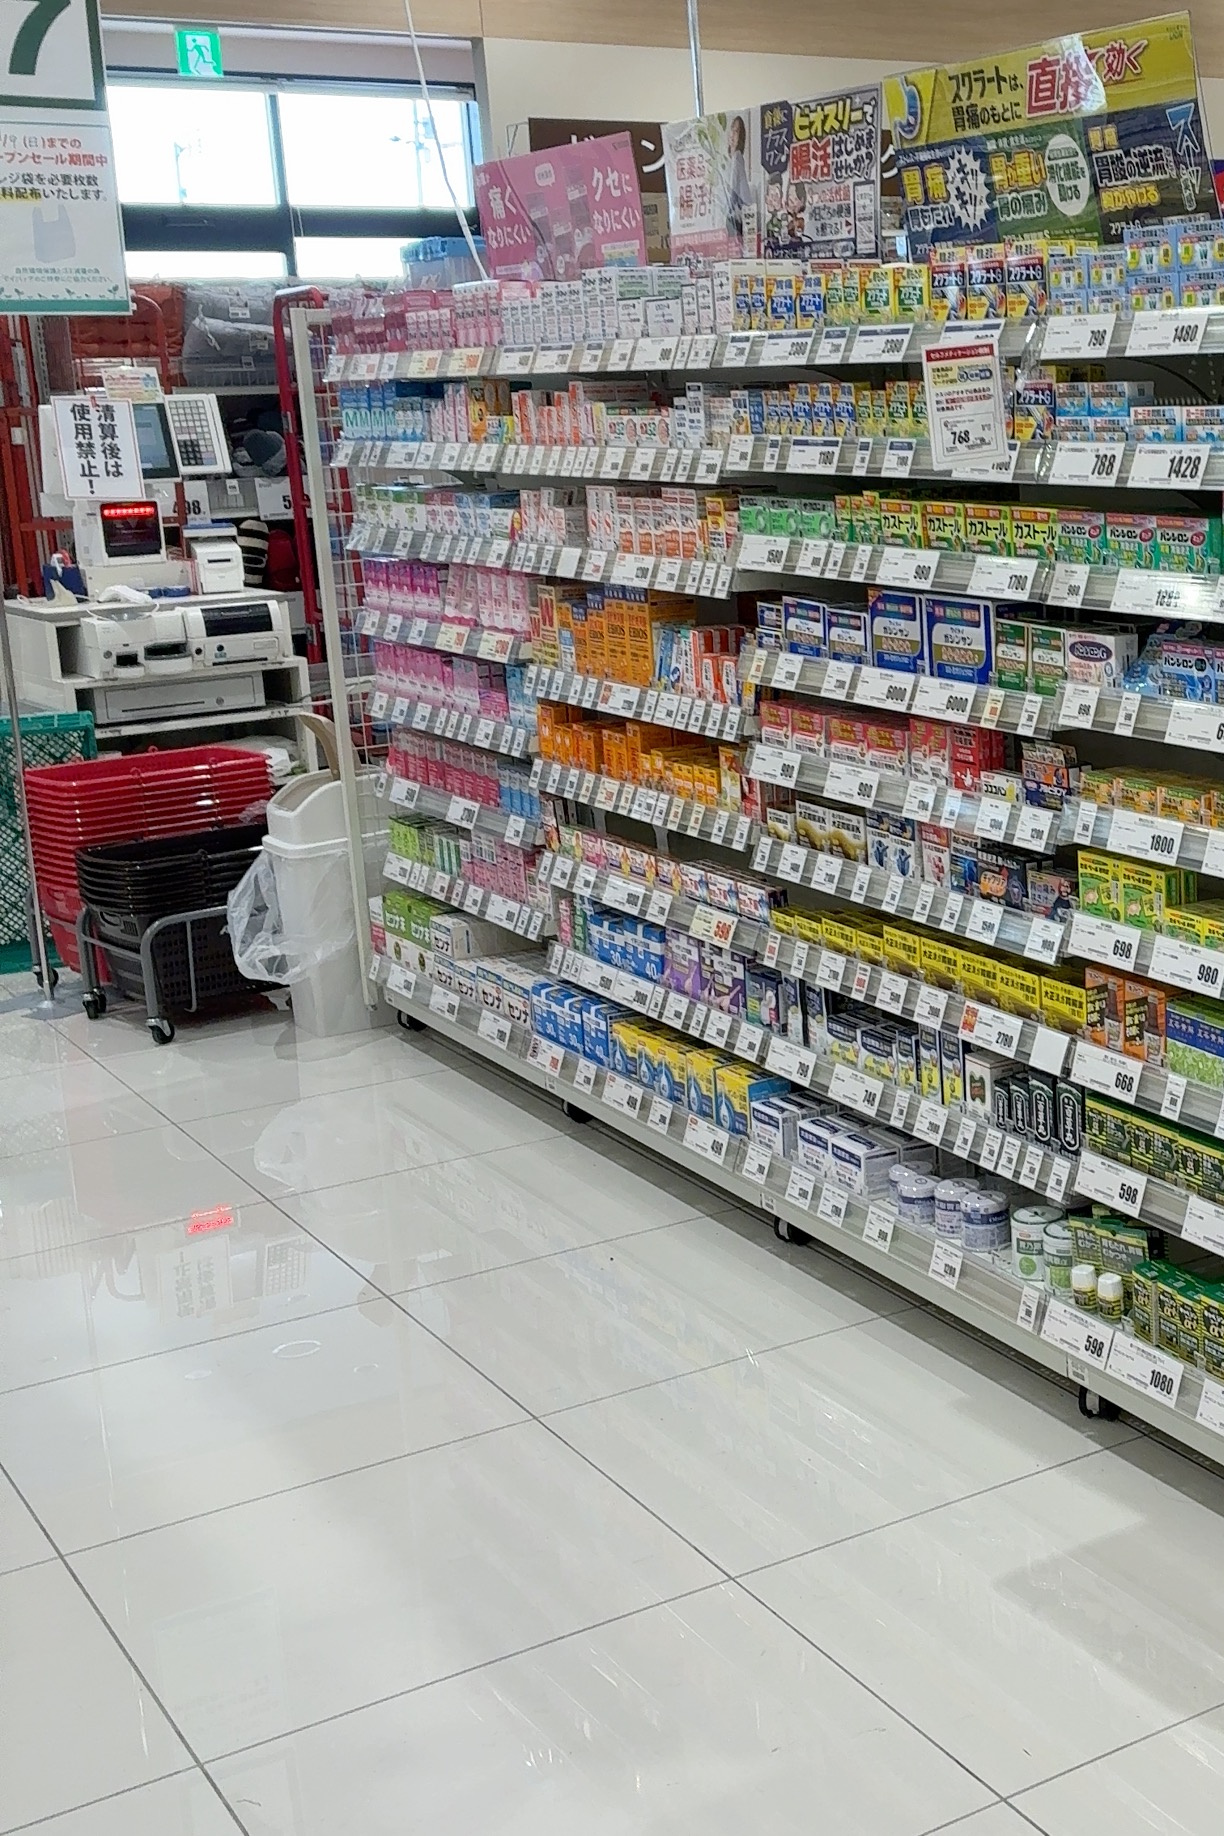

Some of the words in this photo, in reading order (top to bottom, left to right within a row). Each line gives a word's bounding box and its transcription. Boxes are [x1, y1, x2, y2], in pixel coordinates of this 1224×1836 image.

[1173, 325, 1198, 344] 1480
[96, 404, 123, 478] 清算後は
[1091, 453, 1116, 477] 788
[1167, 455, 1201, 479] 1428
[881, 512, 919, 532] カストール
[967, 518, 1008, 539] カストール
[1013, 520, 1057, 541] カストール
[1112, 939, 1133, 960] 698
[1196, 963, 1219, 985] 980
[1114, 1071, 1134, 1092] 668
[1118, 1182, 1139, 1205] 598
